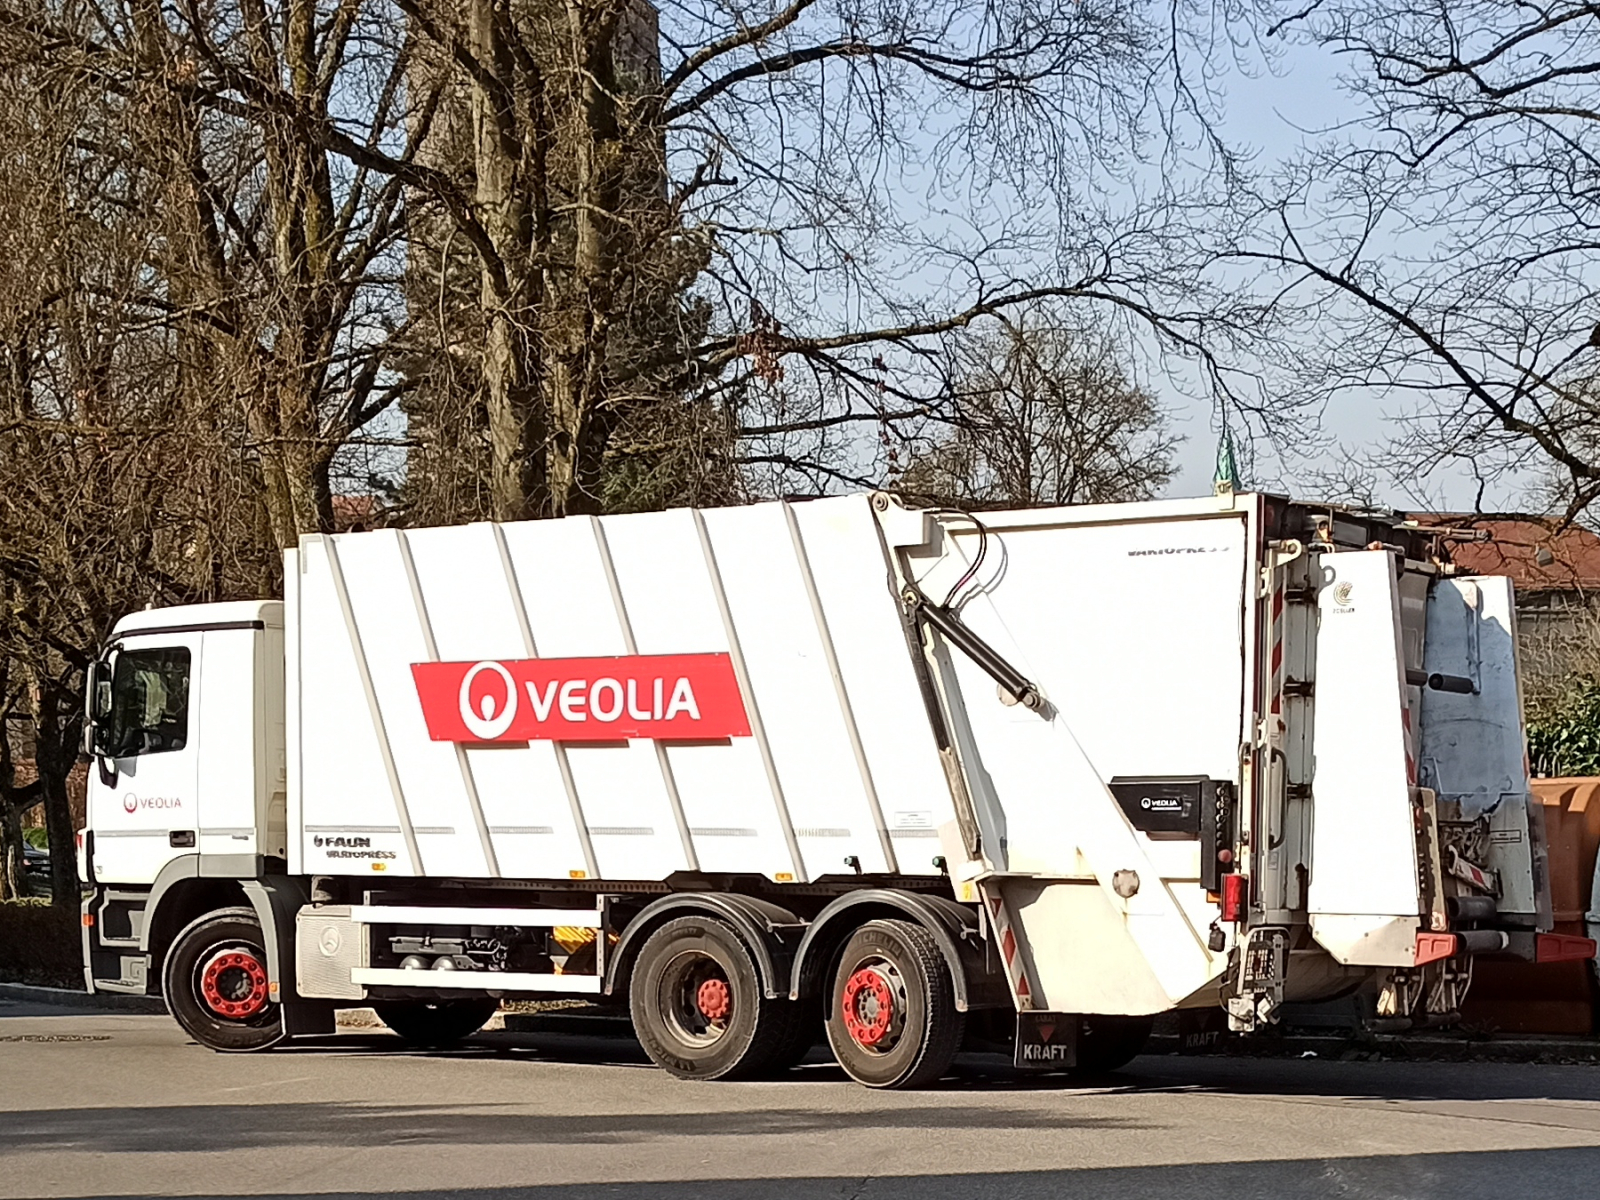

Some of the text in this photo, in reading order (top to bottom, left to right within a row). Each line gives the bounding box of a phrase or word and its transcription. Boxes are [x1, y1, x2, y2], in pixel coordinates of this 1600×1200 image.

[525, 677, 701, 722] VEOLIA
[139, 797, 182, 809] VEOLIA
[325, 837, 370, 848] FAUN
[326, 850, 397, 859] VARIOPRESS
[1185, 1031, 1219, 1048] KRAFT
[1023, 1044, 1067, 1060] KRAFT
